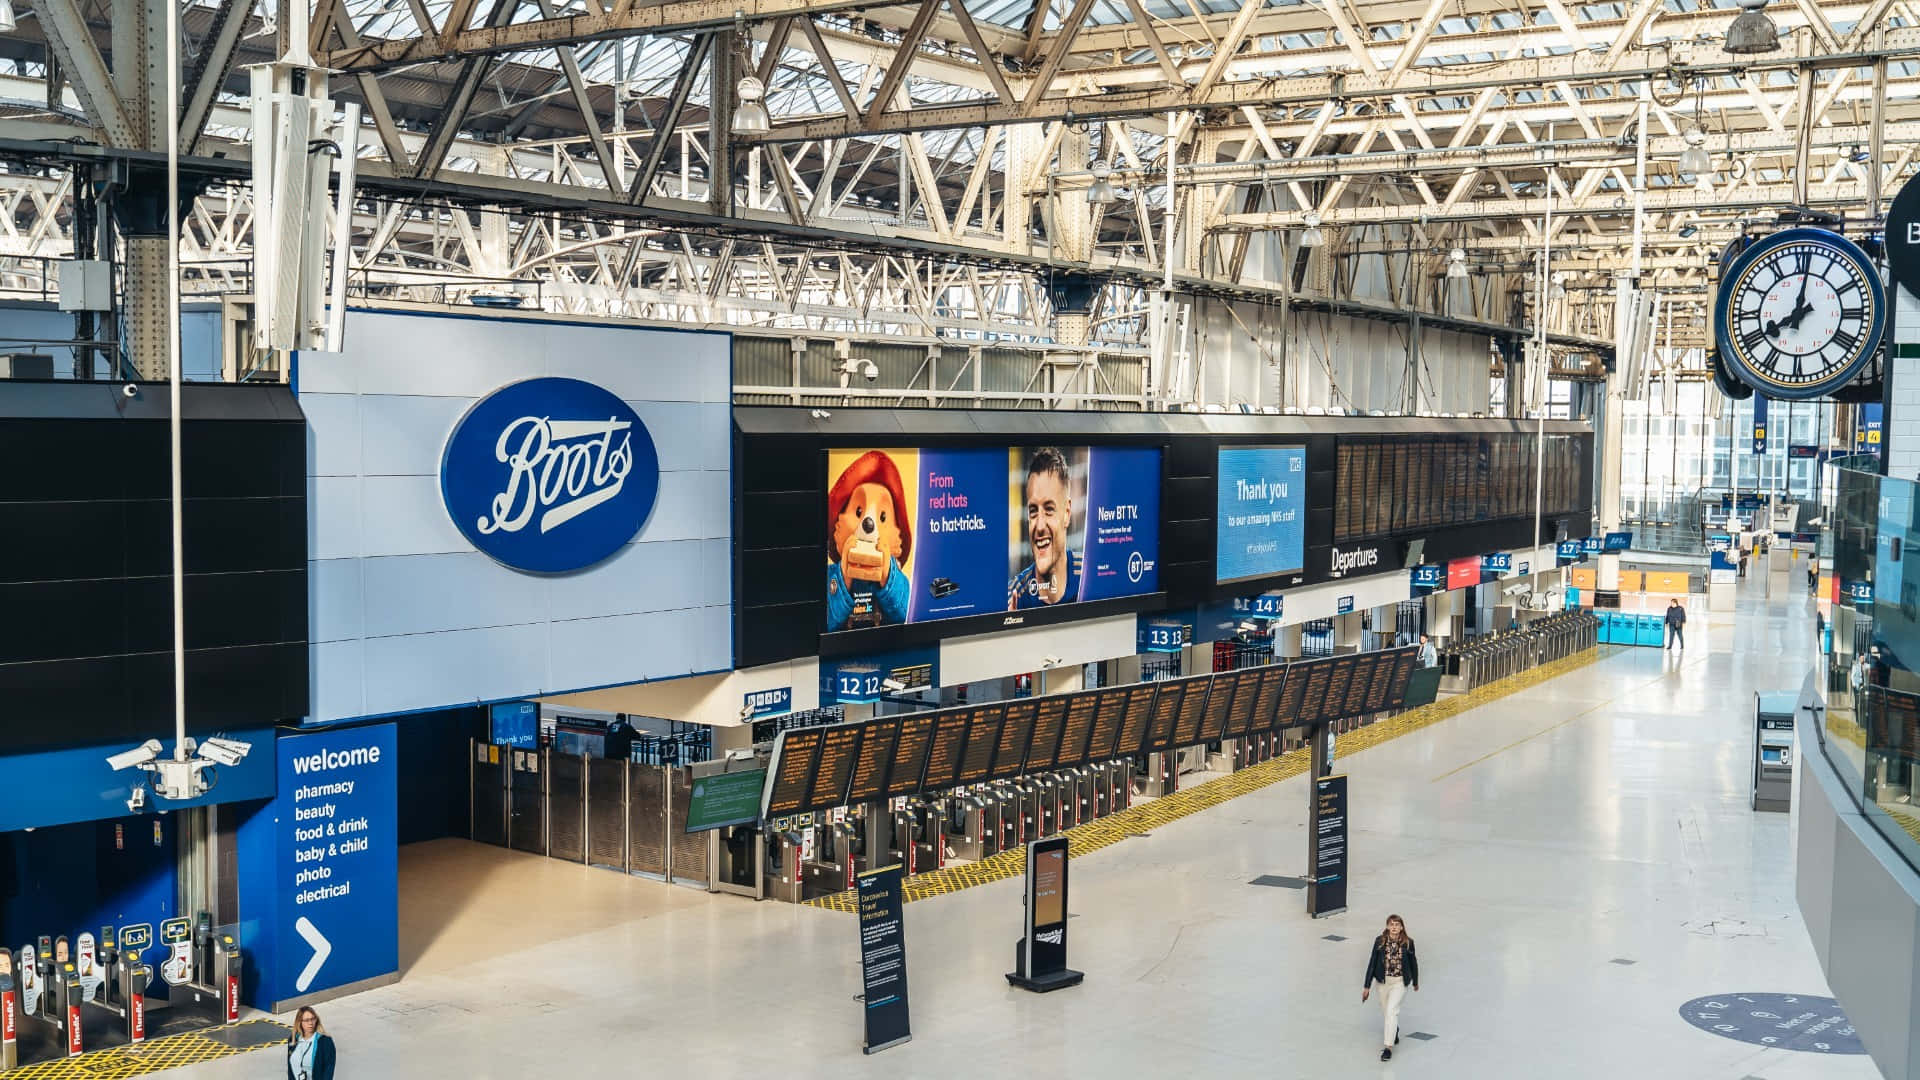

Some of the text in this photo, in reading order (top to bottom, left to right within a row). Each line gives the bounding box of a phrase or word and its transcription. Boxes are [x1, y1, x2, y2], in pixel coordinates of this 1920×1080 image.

[477, 416, 632, 534] Boots
[930, 472, 954, 488] From
[1237, 478, 1288, 504] Thank you
[930, 492, 968, 509] red hats
[1098, 504, 1138, 520] New BT TV.
[1228, 509, 1295, 526] to our amazing NHS staff
[930, 514, 986, 533] to hat-tricks.
[1561, 544, 1574, 554] 17
[1586, 540, 1597, 550] 18
[1332, 546, 1378, 575] Departures
[1492, 557, 1505, 566] 16
[1418, 570, 1433, 581] 15
[1256, 600, 1282, 613] 14 14
[1151, 630, 1182, 645] 13 13
[840, 677, 860, 695] 12
[865, 676, 879, 695] 12
[496, 735, 532, 745] Thank you
[662, 743, 676, 758] 12
[293, 746, 380, 775] welcome
[295, 780, 354, 802] pharmacy
[295, 803, 336, 820] beauty
[295, 817, 368, 842] food & drink
[296, 836, 368, 862] baby & child
[296, 866, 331, 886] photo
[296, 881, 350, 904] electrical
